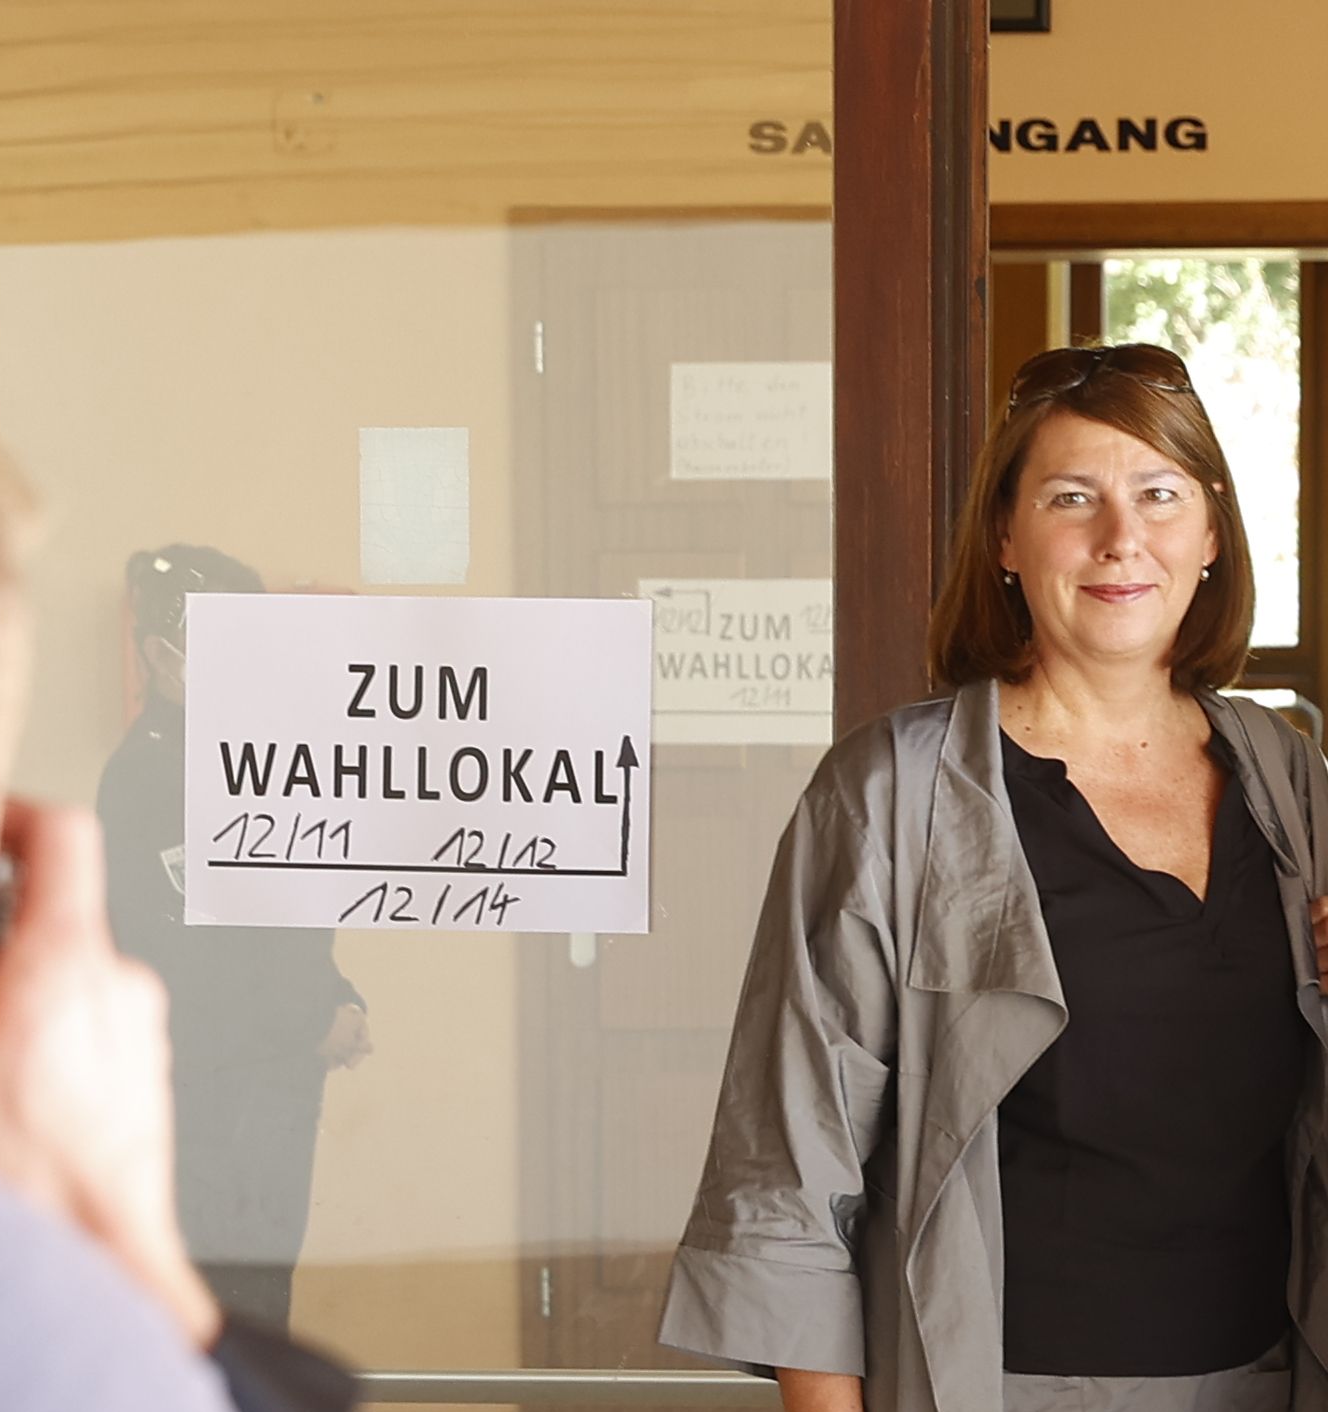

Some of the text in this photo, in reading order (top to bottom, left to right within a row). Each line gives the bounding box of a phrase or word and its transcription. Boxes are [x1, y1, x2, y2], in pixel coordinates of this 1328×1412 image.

[719, 613, 791, 641] ZUM
[347, 664, 488, 721] ZUM
[220, 742, 618, 803] WAHLLOKAL
[213, 813, 559, 869] 12/11 12/12
